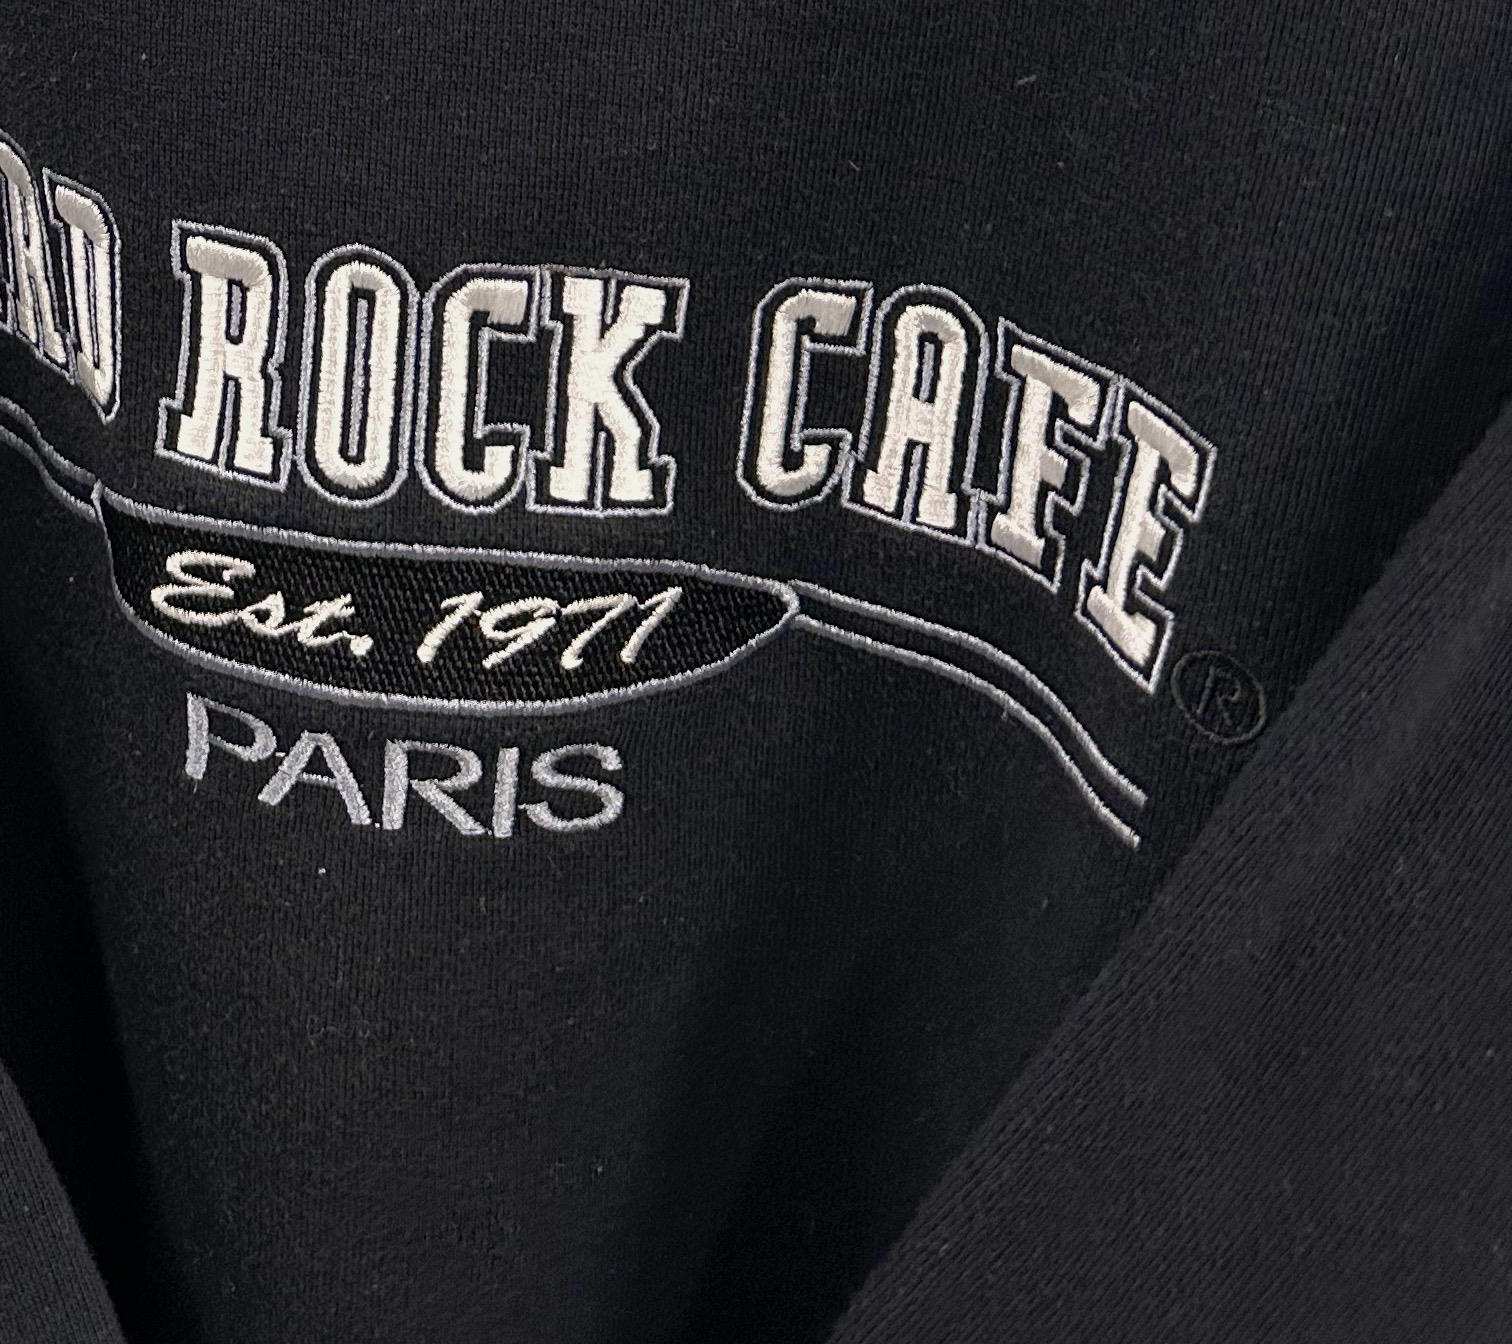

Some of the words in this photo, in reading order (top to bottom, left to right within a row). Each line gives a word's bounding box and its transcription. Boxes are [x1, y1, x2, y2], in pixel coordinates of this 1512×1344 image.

[157, 219, 690, 517] ROCK
[736, 276, 1217, 694] CAFE
[150, 550, 374, 657] Est.
[416, 586, 683, 670] 1971
[185, 691, 625, 839] PARIS
